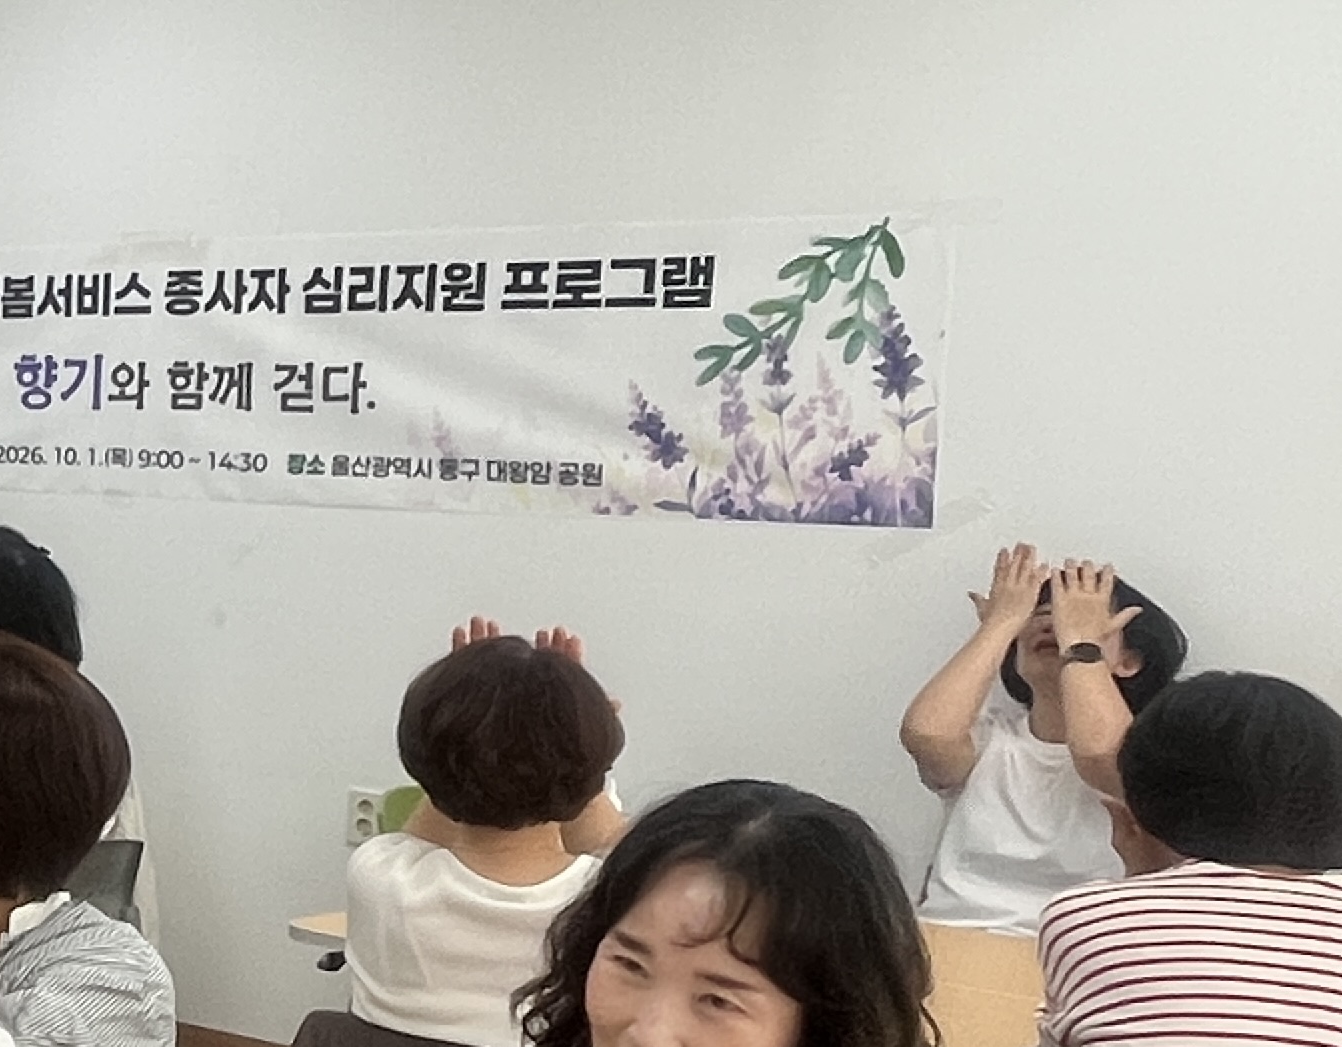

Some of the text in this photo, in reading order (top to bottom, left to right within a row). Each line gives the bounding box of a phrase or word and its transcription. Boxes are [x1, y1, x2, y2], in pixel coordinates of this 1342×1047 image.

[164, 267, 291, 316] 종사자
[302, 261, 487, 314] 심리지원
[500, 253, 716, 311] 프로그램
[13, 353, 151, 411] 향기와
[167, 361, 253, 412] 함께
[272, 361, 376, 414] 걷다.
[54, 446, 82, 466] 10.
[138, 449, 185, 469] 9:00
[208, 451, 268, 473] 14:30
[330, 454, 432, 479] 울산광역시
[438, 457, 480, 482] 동구
[485, 458, 552, 485] 대왕암
[557, 462, 604, 487] 공원
